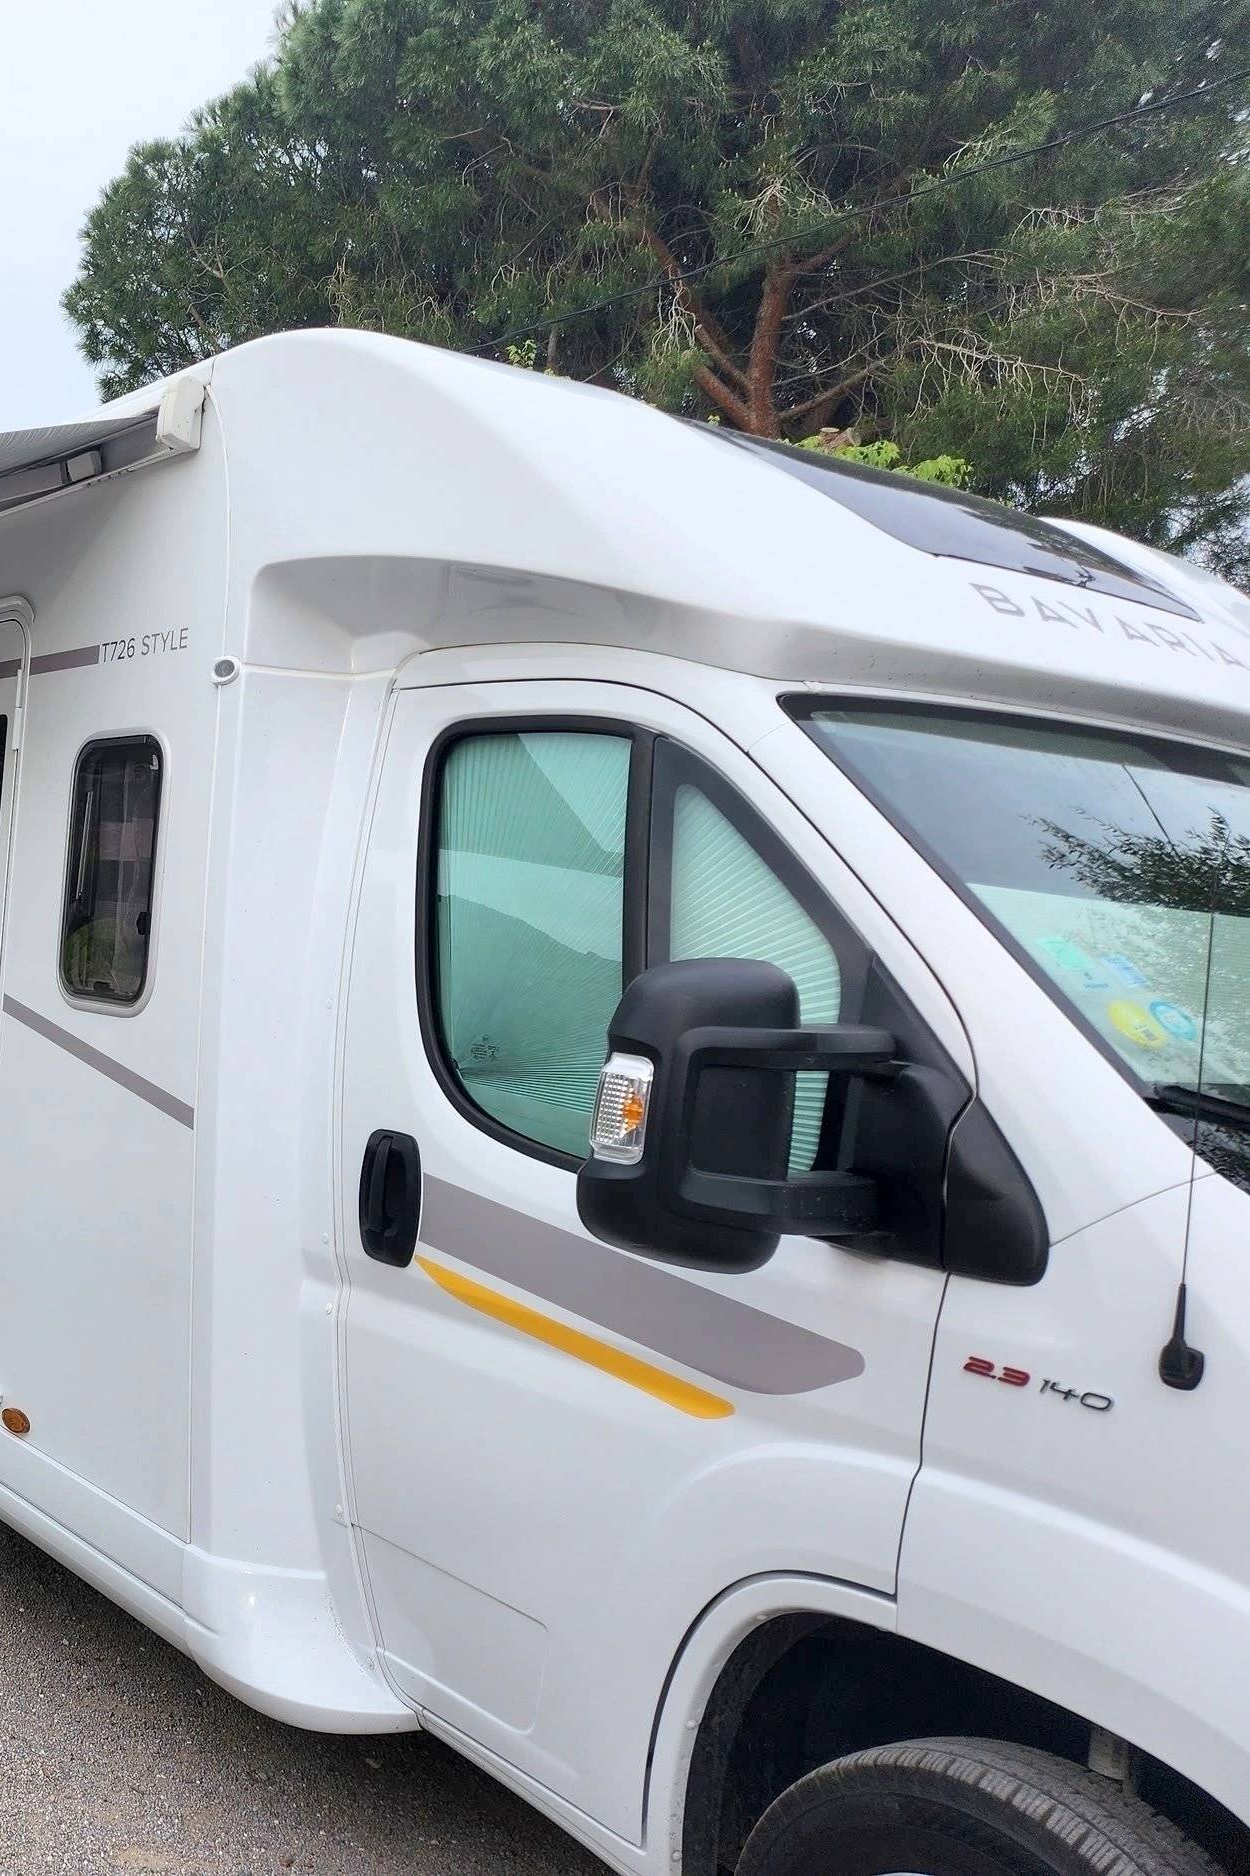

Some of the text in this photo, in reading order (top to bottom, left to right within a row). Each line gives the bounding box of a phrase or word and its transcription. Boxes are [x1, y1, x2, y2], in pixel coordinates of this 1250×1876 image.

[968, 581, 1250, 671] BAVARIA
[101, 627, 189, 663] T726 STYLE
[1039, 1378, 1114, 1411] 140
